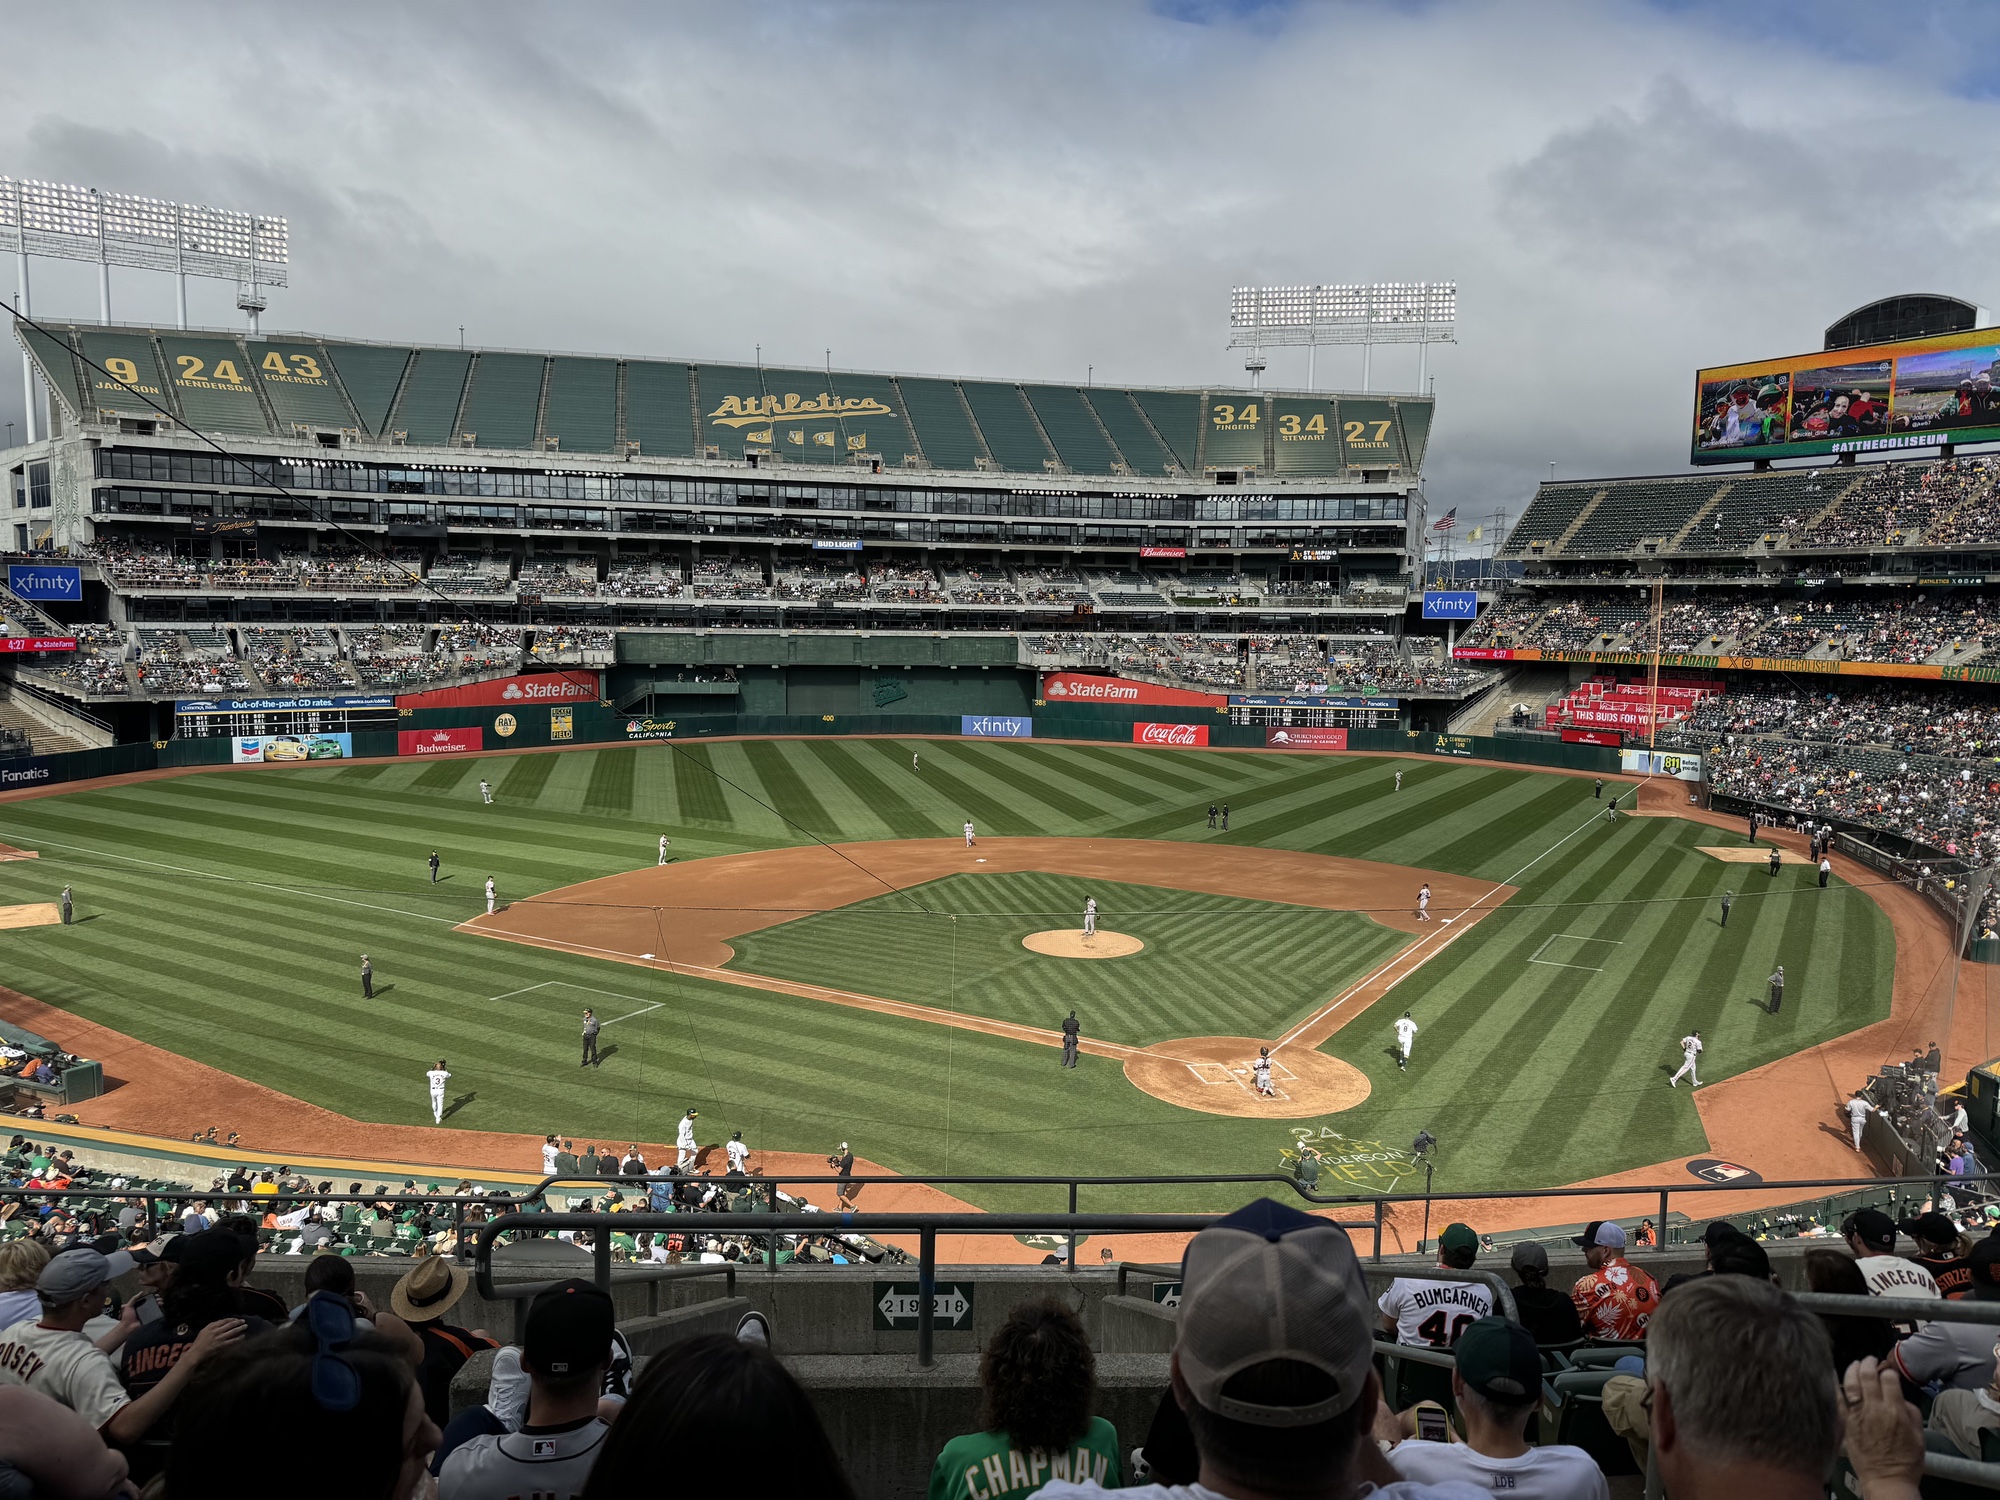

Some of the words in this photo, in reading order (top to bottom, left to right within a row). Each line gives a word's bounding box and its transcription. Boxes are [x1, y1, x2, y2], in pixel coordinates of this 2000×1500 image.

[104, 357, 139, 384] 9
[176, 355, 244, 384] 24
[262, 351, 322, 378] 43
[175, 379, 253, 393] HENDERSON
[264, 373, 329, 386] ECKERSLEY
[707, 392, 891, 427] Athletics
[1213, 404, 1260, 424] 34
[1279, 414, 1328, 435] 34
[1344, 420, 1392, 442] 27
[1282, 434, 1326, 442] STEWART
[1831, 433, 1948, 453] #ATTHECOLISEUM
[210, 520, 256, 534] Treehouse
[817, 540, 834, 548] BUD
[1142, 547, 1184, 557] Budweiser
[15, 573, 75, 593] xfinity
[1806, 578, 1825, 586] VALLEY
[1427, 597, 1473, 613] xfinity
[8, 640, 25, 650] 4:27
[43, 640, 74, 648] StateFarm
[1492, 650, 1507, 658] 4:27
[1540, 650, 1560, 661] SEE
[1562, 650, 1593, 662] YOUR
[1594, 652, 1638, 663] PHOTOS
[1640, 653, 1655, 665] ON
[1658, 654, 1680, 666] THE
[1681, 655, 1719, 667] BOARD
[1761, 658, 1840, 674] #ATTHECOLISEUM
[1941, 666, 1965, 680] SEE
[524, 682, 594, 699] StateFarm
[1068, 681, 1139, 700] StateFarm
[231, 700, 297, 710] Out-of-the-park
[298, 699, 311, 707] CD
[312, 699, 334, 707] rates.
[498, 717, 513, 727] RAY
[822, 714, 835, 722] 400
[1576, 710, 1594, 720] THIS
[1596, 711, 1618, 722] BUDS
[1620, 713, 1637, 724] FOR
[641, 719, 677, 732] Sports
[973, 717, 1022, 736] xfinity
[552, 730, 571, 739] FIELD
[1142, 723, 1197, 745] Coca-Cola
[1406, 730, 1420, 738] 367
[1665, 757, 1680, 768] 811
[1, 767, 49, 783] Fanatics
[435, 1077, 441, 1086] 3
[1289, 1125, 1346, 1143] 24
[1322, 1161, 1417, 1181] IELD
[667, 1240, 683, 1251] 20
[1868, 1269, 1937, 1296] LINCECUM
[884, 1299, 919, 1313] 219
[1413, 1288, 1489, 1318] BUMGARNER
[965, 1446, 1108, 1500] CHAPMAN
[1494, 1475, 1515, 1488] LDB
